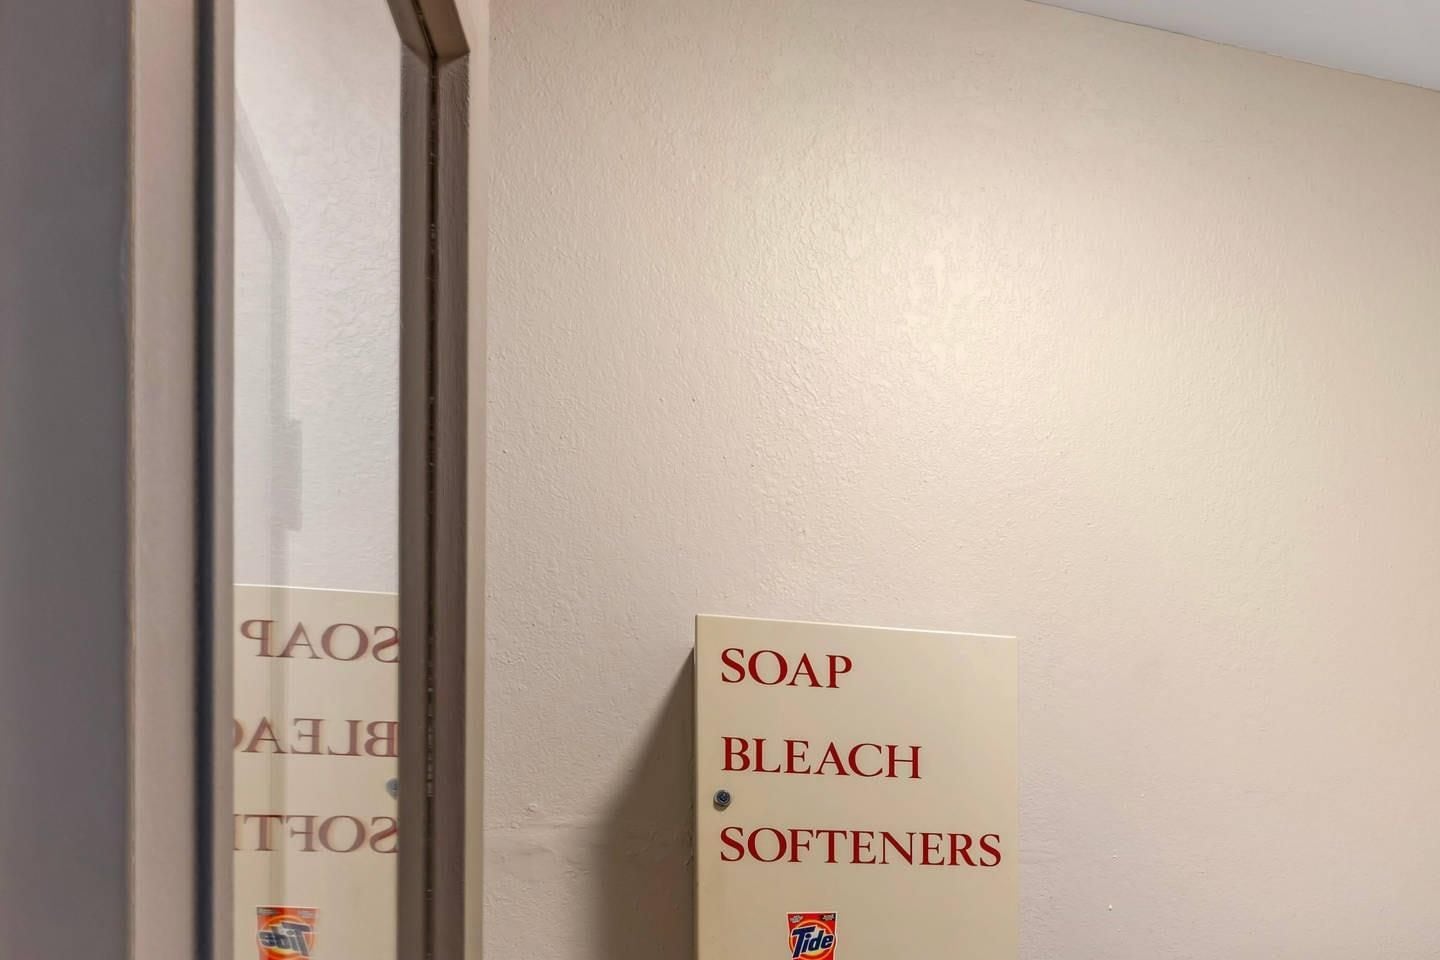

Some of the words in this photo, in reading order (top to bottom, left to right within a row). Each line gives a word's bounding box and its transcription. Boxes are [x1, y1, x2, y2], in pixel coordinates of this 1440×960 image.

[720, 647, 853, 689] SOAP
[720, 736, 922, 779] BLEACH
[720, 826, 1001, 868] SOFTENERS
[791, 925, 835, 959] Tide
